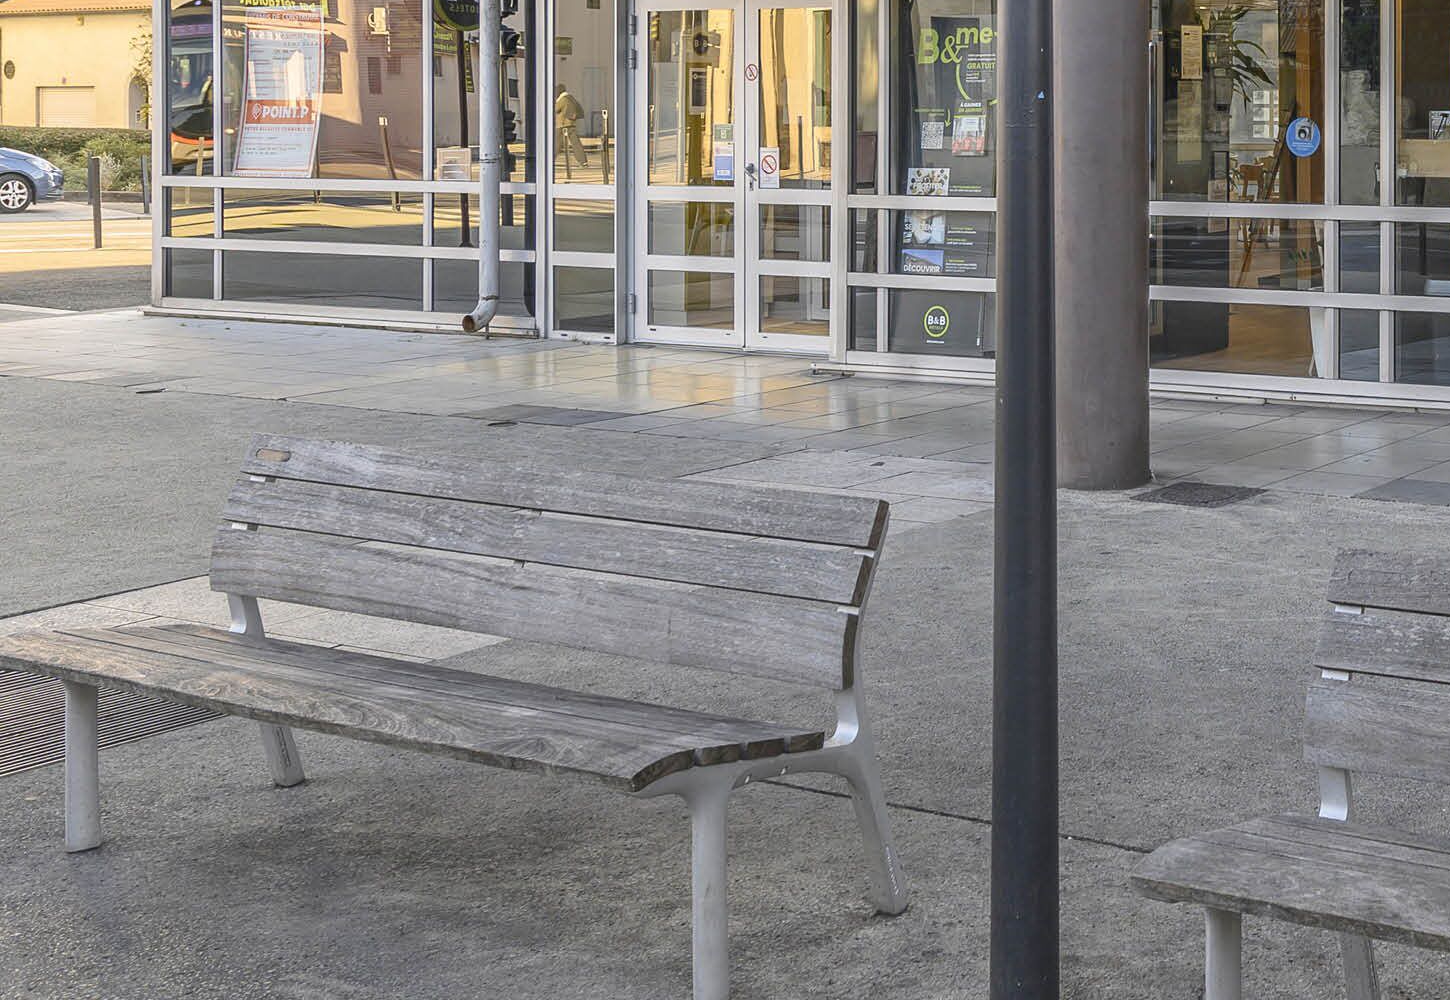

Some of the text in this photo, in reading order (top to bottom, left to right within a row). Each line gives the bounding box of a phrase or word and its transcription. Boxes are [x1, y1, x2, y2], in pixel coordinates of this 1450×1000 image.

[966, 62, 996, 70] GRATUIT
[262, 104, 309, 119] POINT.P
[903, 263, 941, 273] DÉCOUVRIR
[927, 315, 946, 326] B&B
